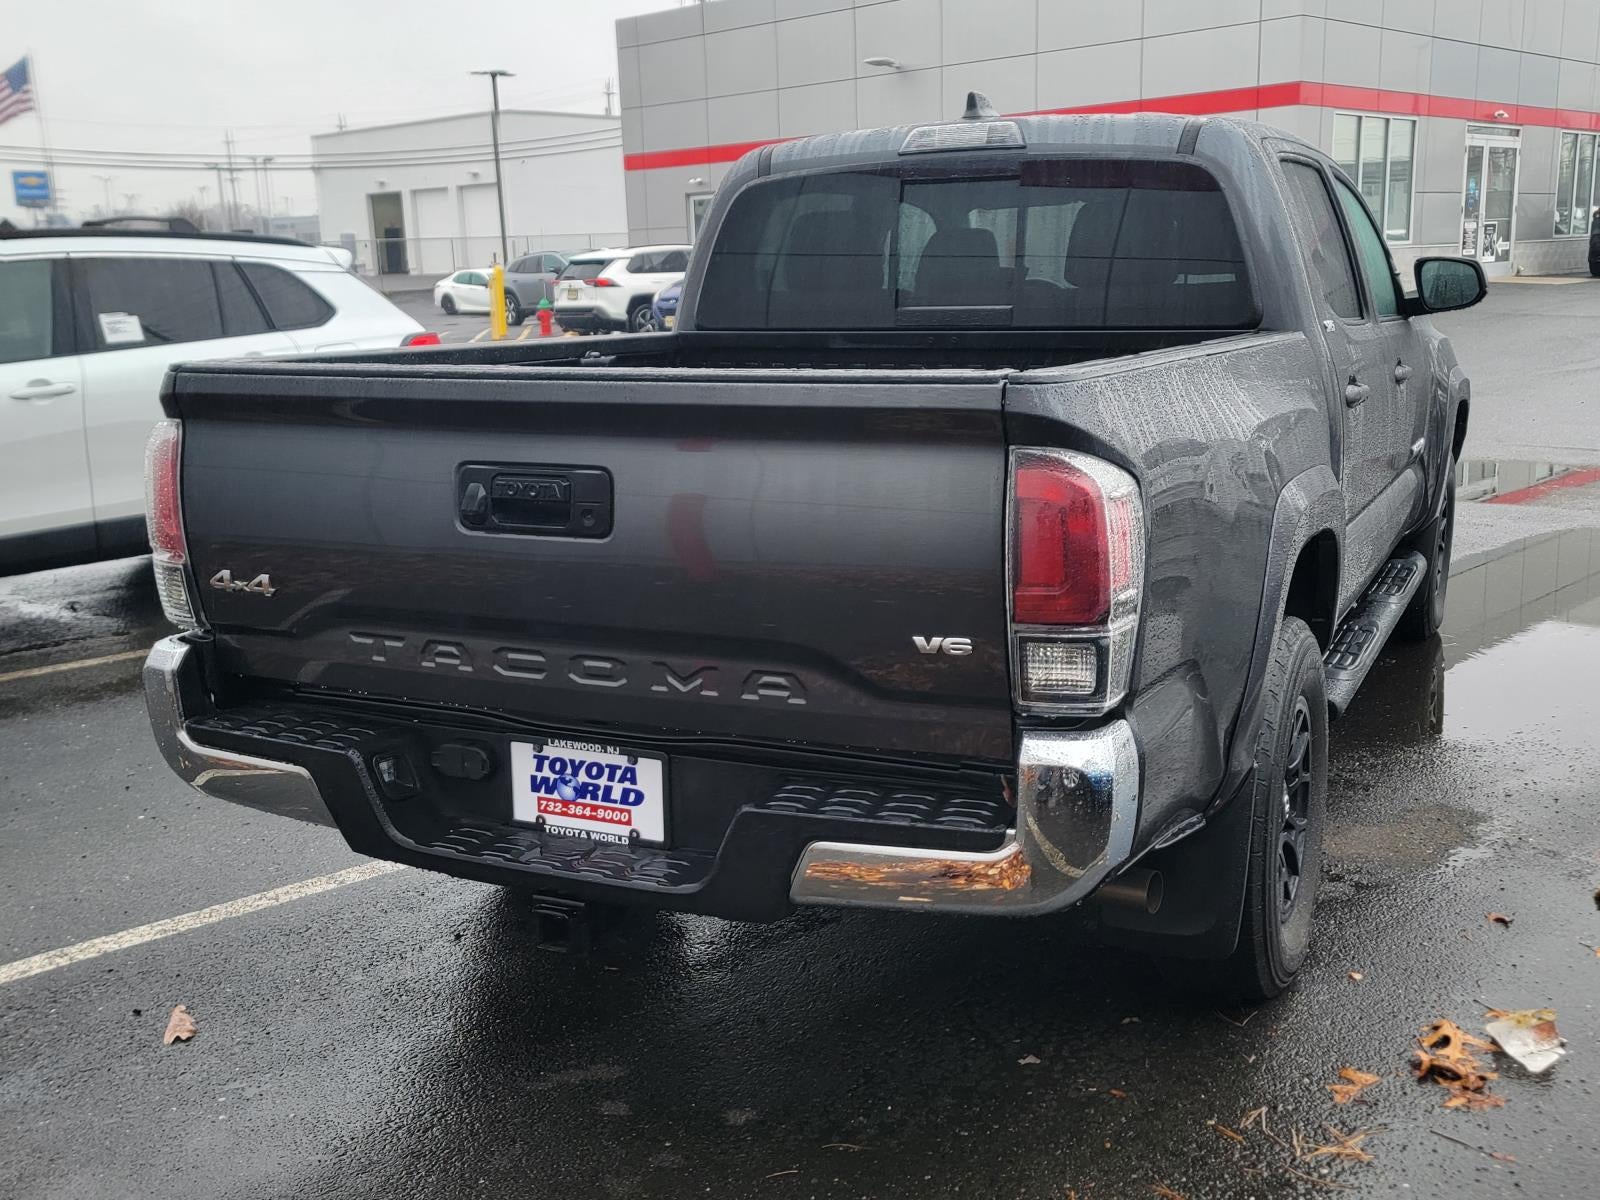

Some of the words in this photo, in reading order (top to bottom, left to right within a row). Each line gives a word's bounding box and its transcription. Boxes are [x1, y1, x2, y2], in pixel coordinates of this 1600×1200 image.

[495, 480, 564, 499] TOYOTA
[911, 635, 973, 656] V6
[348, 631, 808, 705] TACOMA
[548, 738, 605, 754] LAKEWOOD,
[606, 744, 620, 755] NJ
[532, 753, 639, 786] TOYOTA
[539, 800, 630, 823] 732-364-9000
[543, 824, 588, 839] TOYOTA
[589, 830, 630, 845] WORLD
